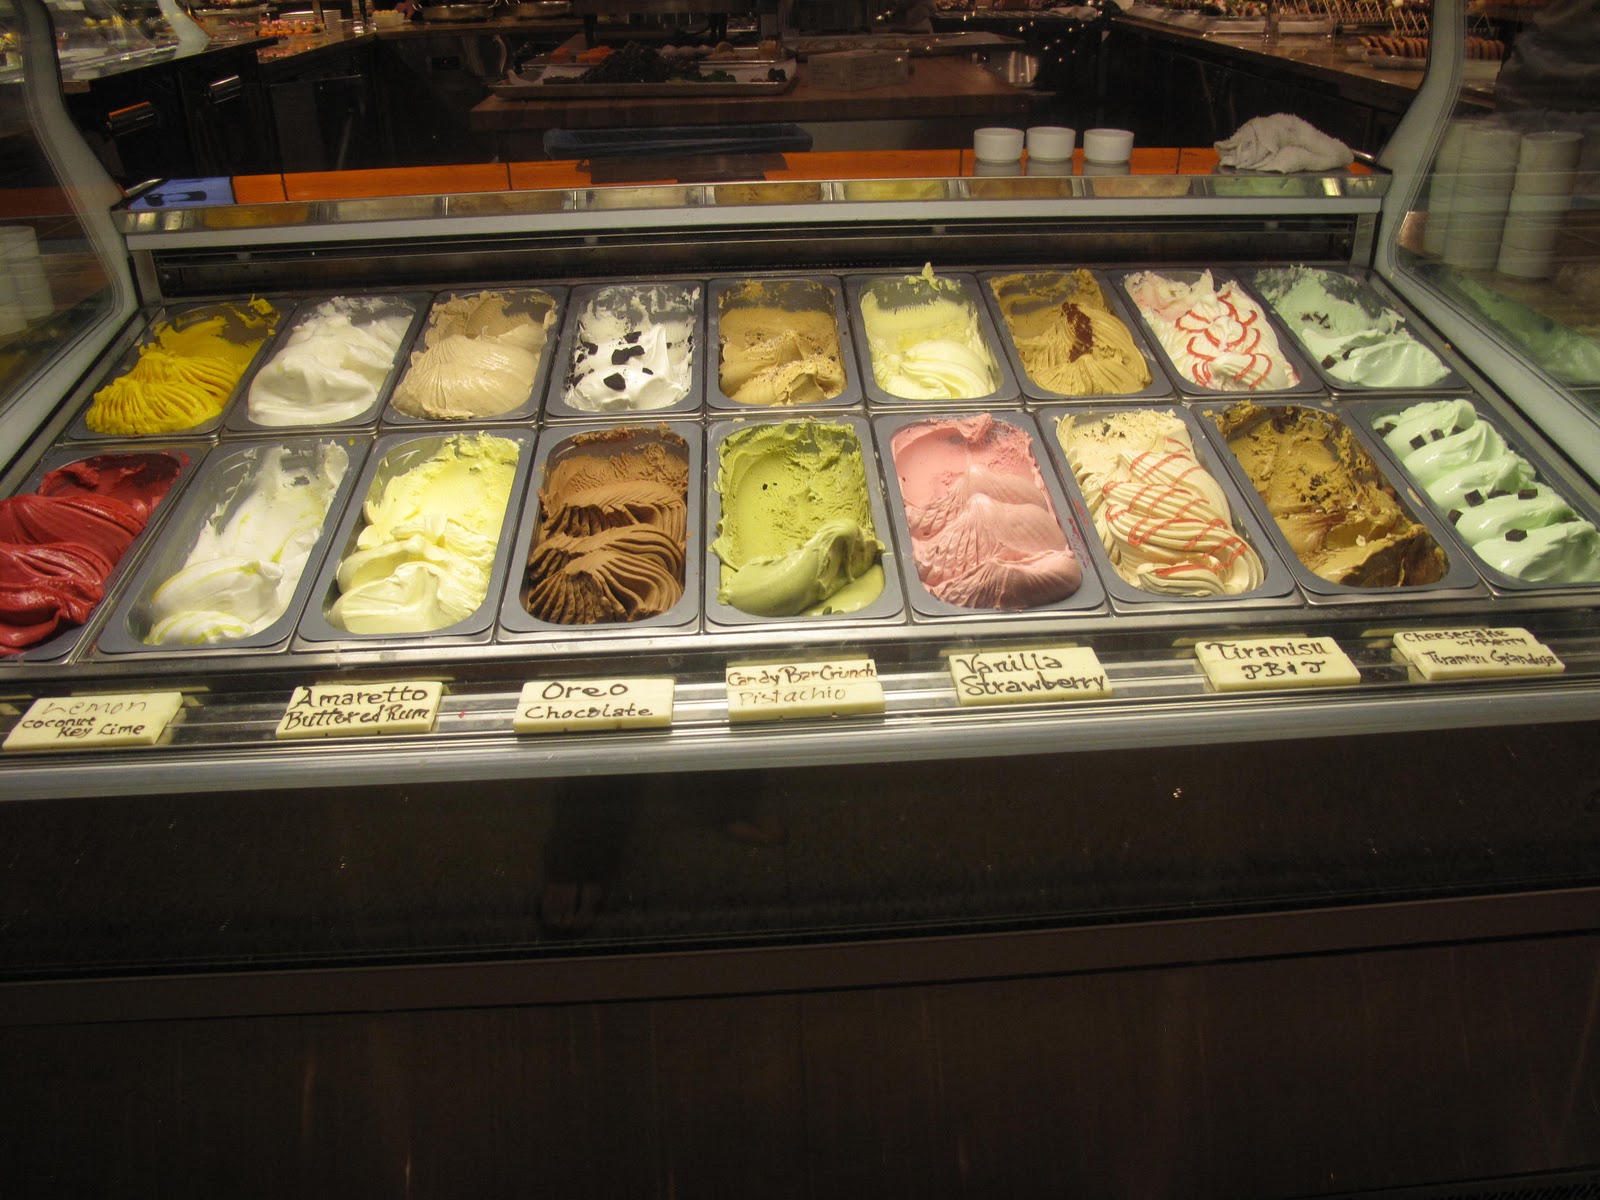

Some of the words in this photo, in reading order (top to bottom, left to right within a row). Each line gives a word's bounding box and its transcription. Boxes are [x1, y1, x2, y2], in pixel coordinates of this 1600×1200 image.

[1402, 628, 1509, 643] Cheesecake
[1205, 642, 1330, 660] Tiramisu
[956, 653, 1063, 674] Vanilla
[727, 670, 780, 687] Candy
[819, 663, 877, 680] Crunch
[960, 671, 1104, 696] Strawberry
[289, 685, 428, 710] Amaretto
[739, 686, 846, 706] Pistachio
[42, 701, 147, 715] Lemon
[284, 705, 386, 731] Buttered
[384, 703, 430, 722] Rum
[524, 703, 653, 719] Chocolate
[98, 723, 145, 735] Lime
